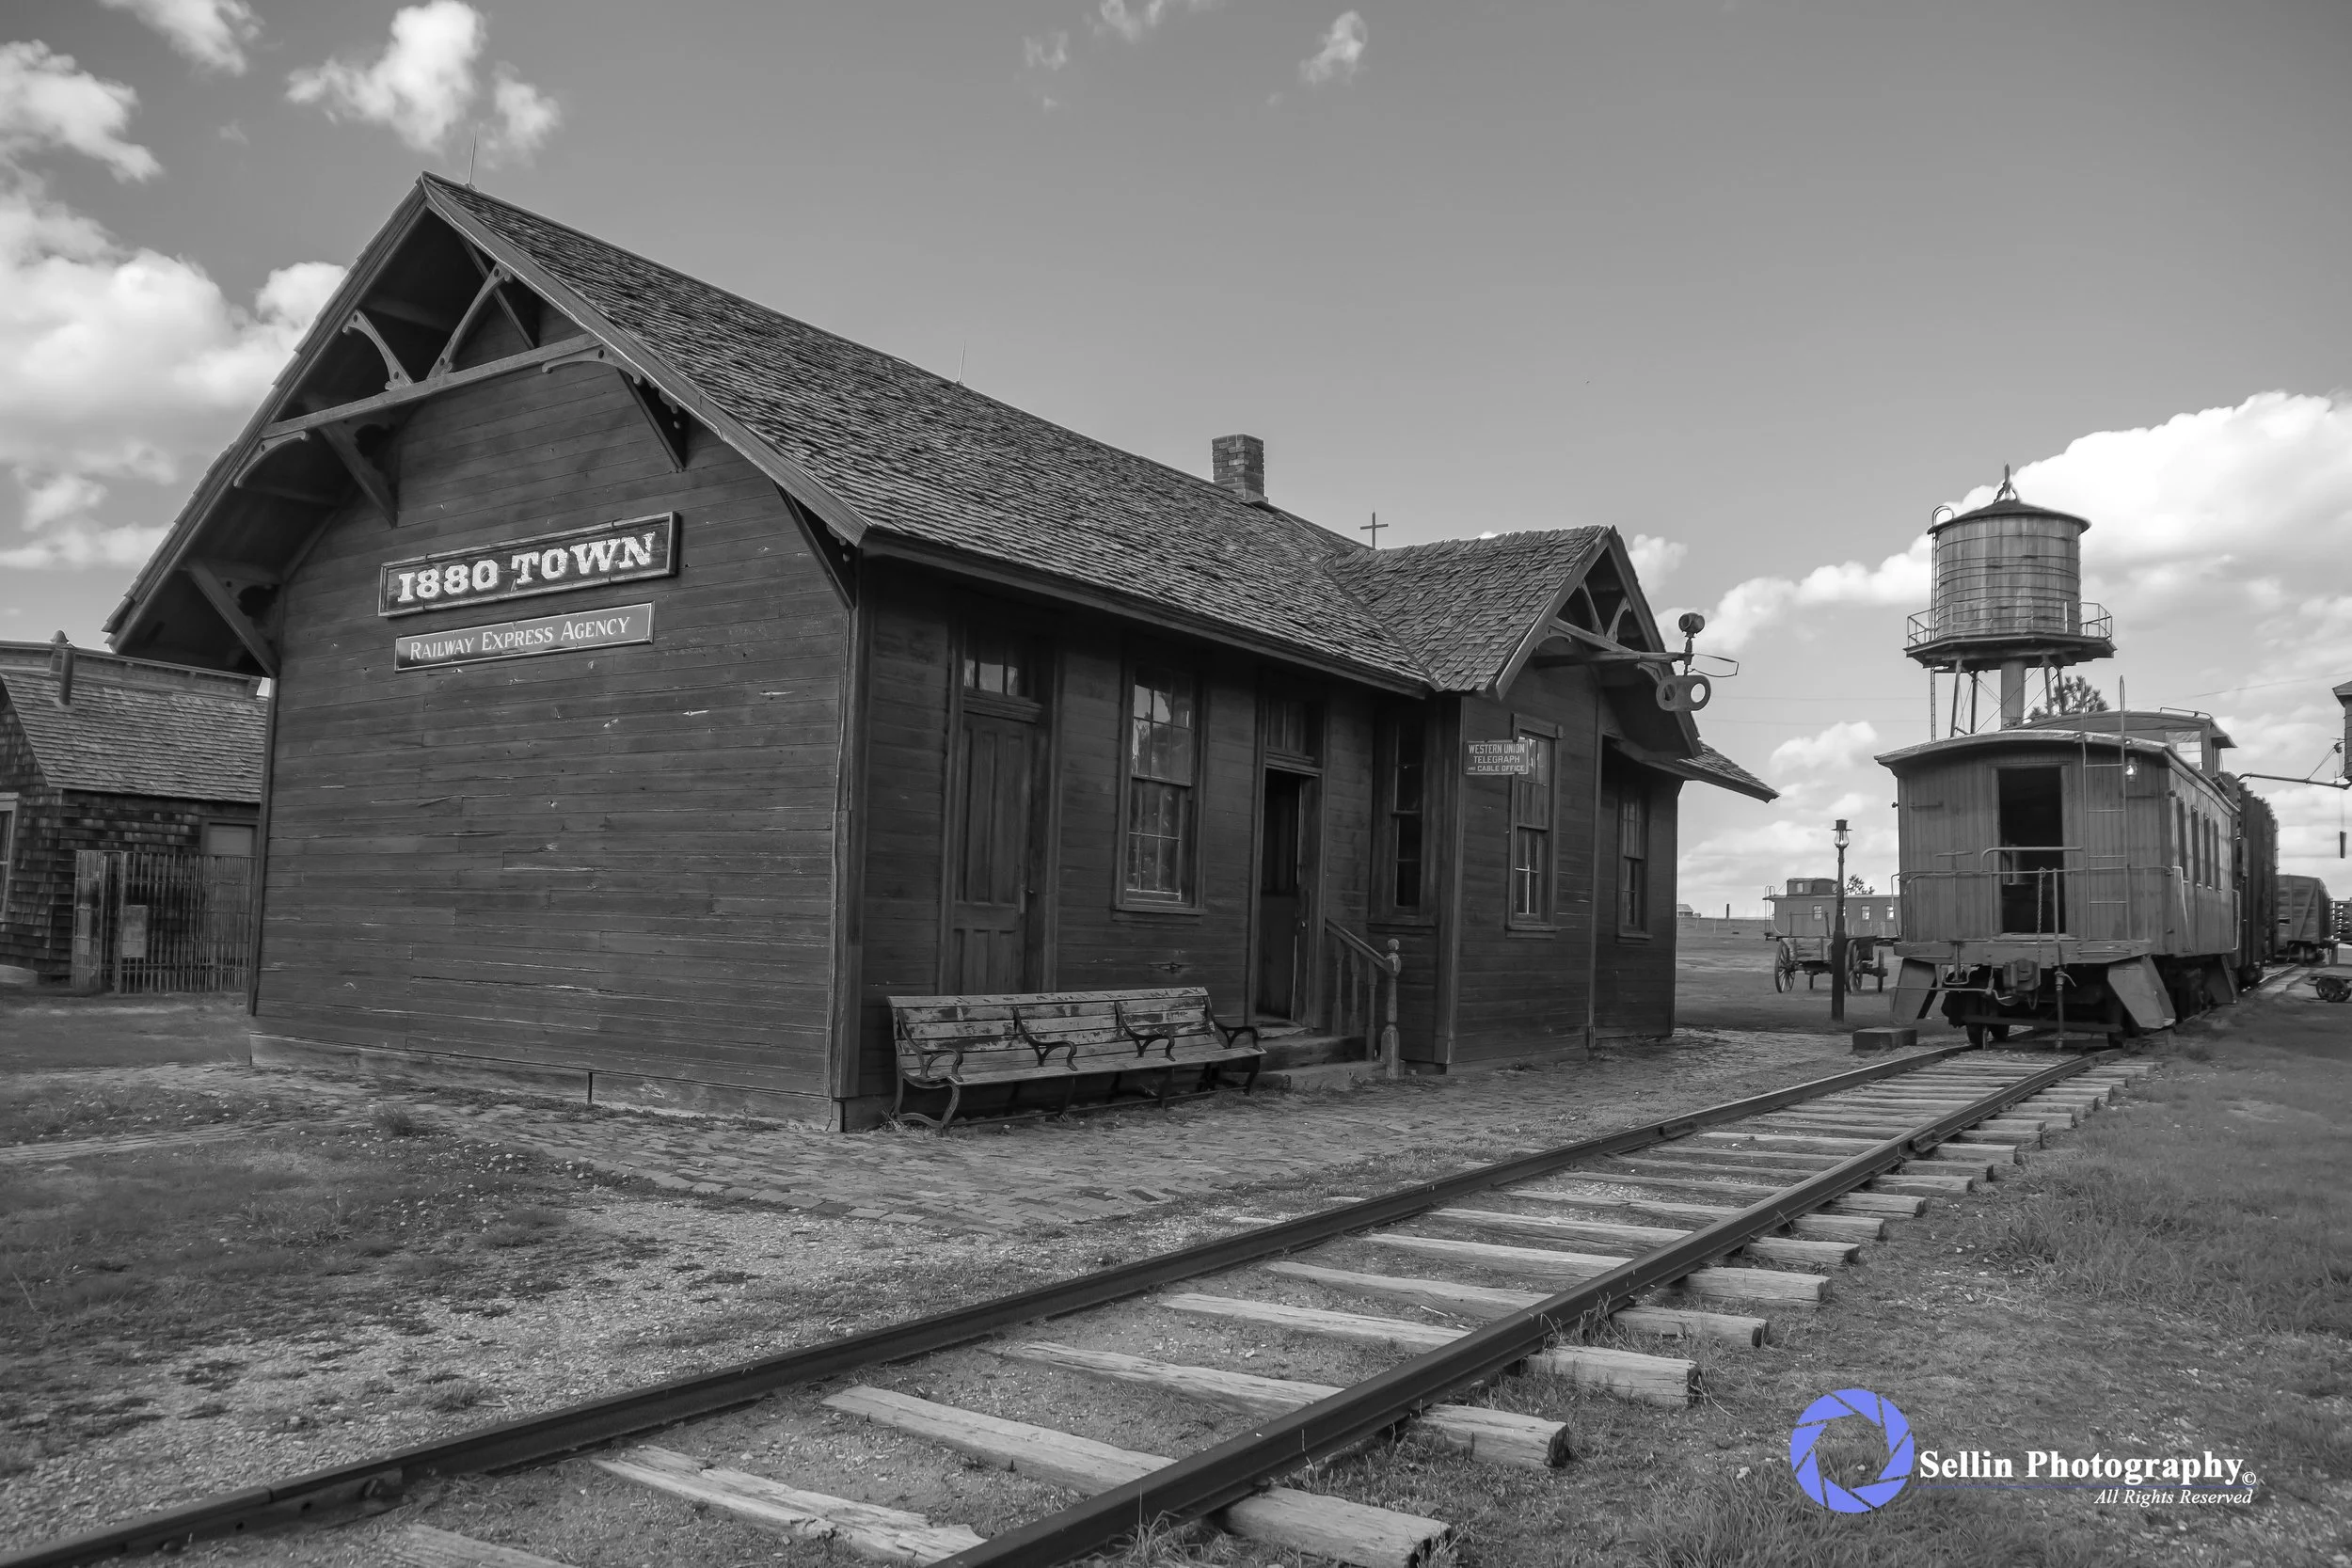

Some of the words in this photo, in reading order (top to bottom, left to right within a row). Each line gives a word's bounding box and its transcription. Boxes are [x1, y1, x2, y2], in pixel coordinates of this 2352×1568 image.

[397, 563, 499, 602] 1880
[511, 531, 656, 584] TOWN
[1469, 744, 1502, 754] WESTERN
[1504, 743, 1525, 753] UNION
[1473, 755, 1520, 764] TELEGRAPH
